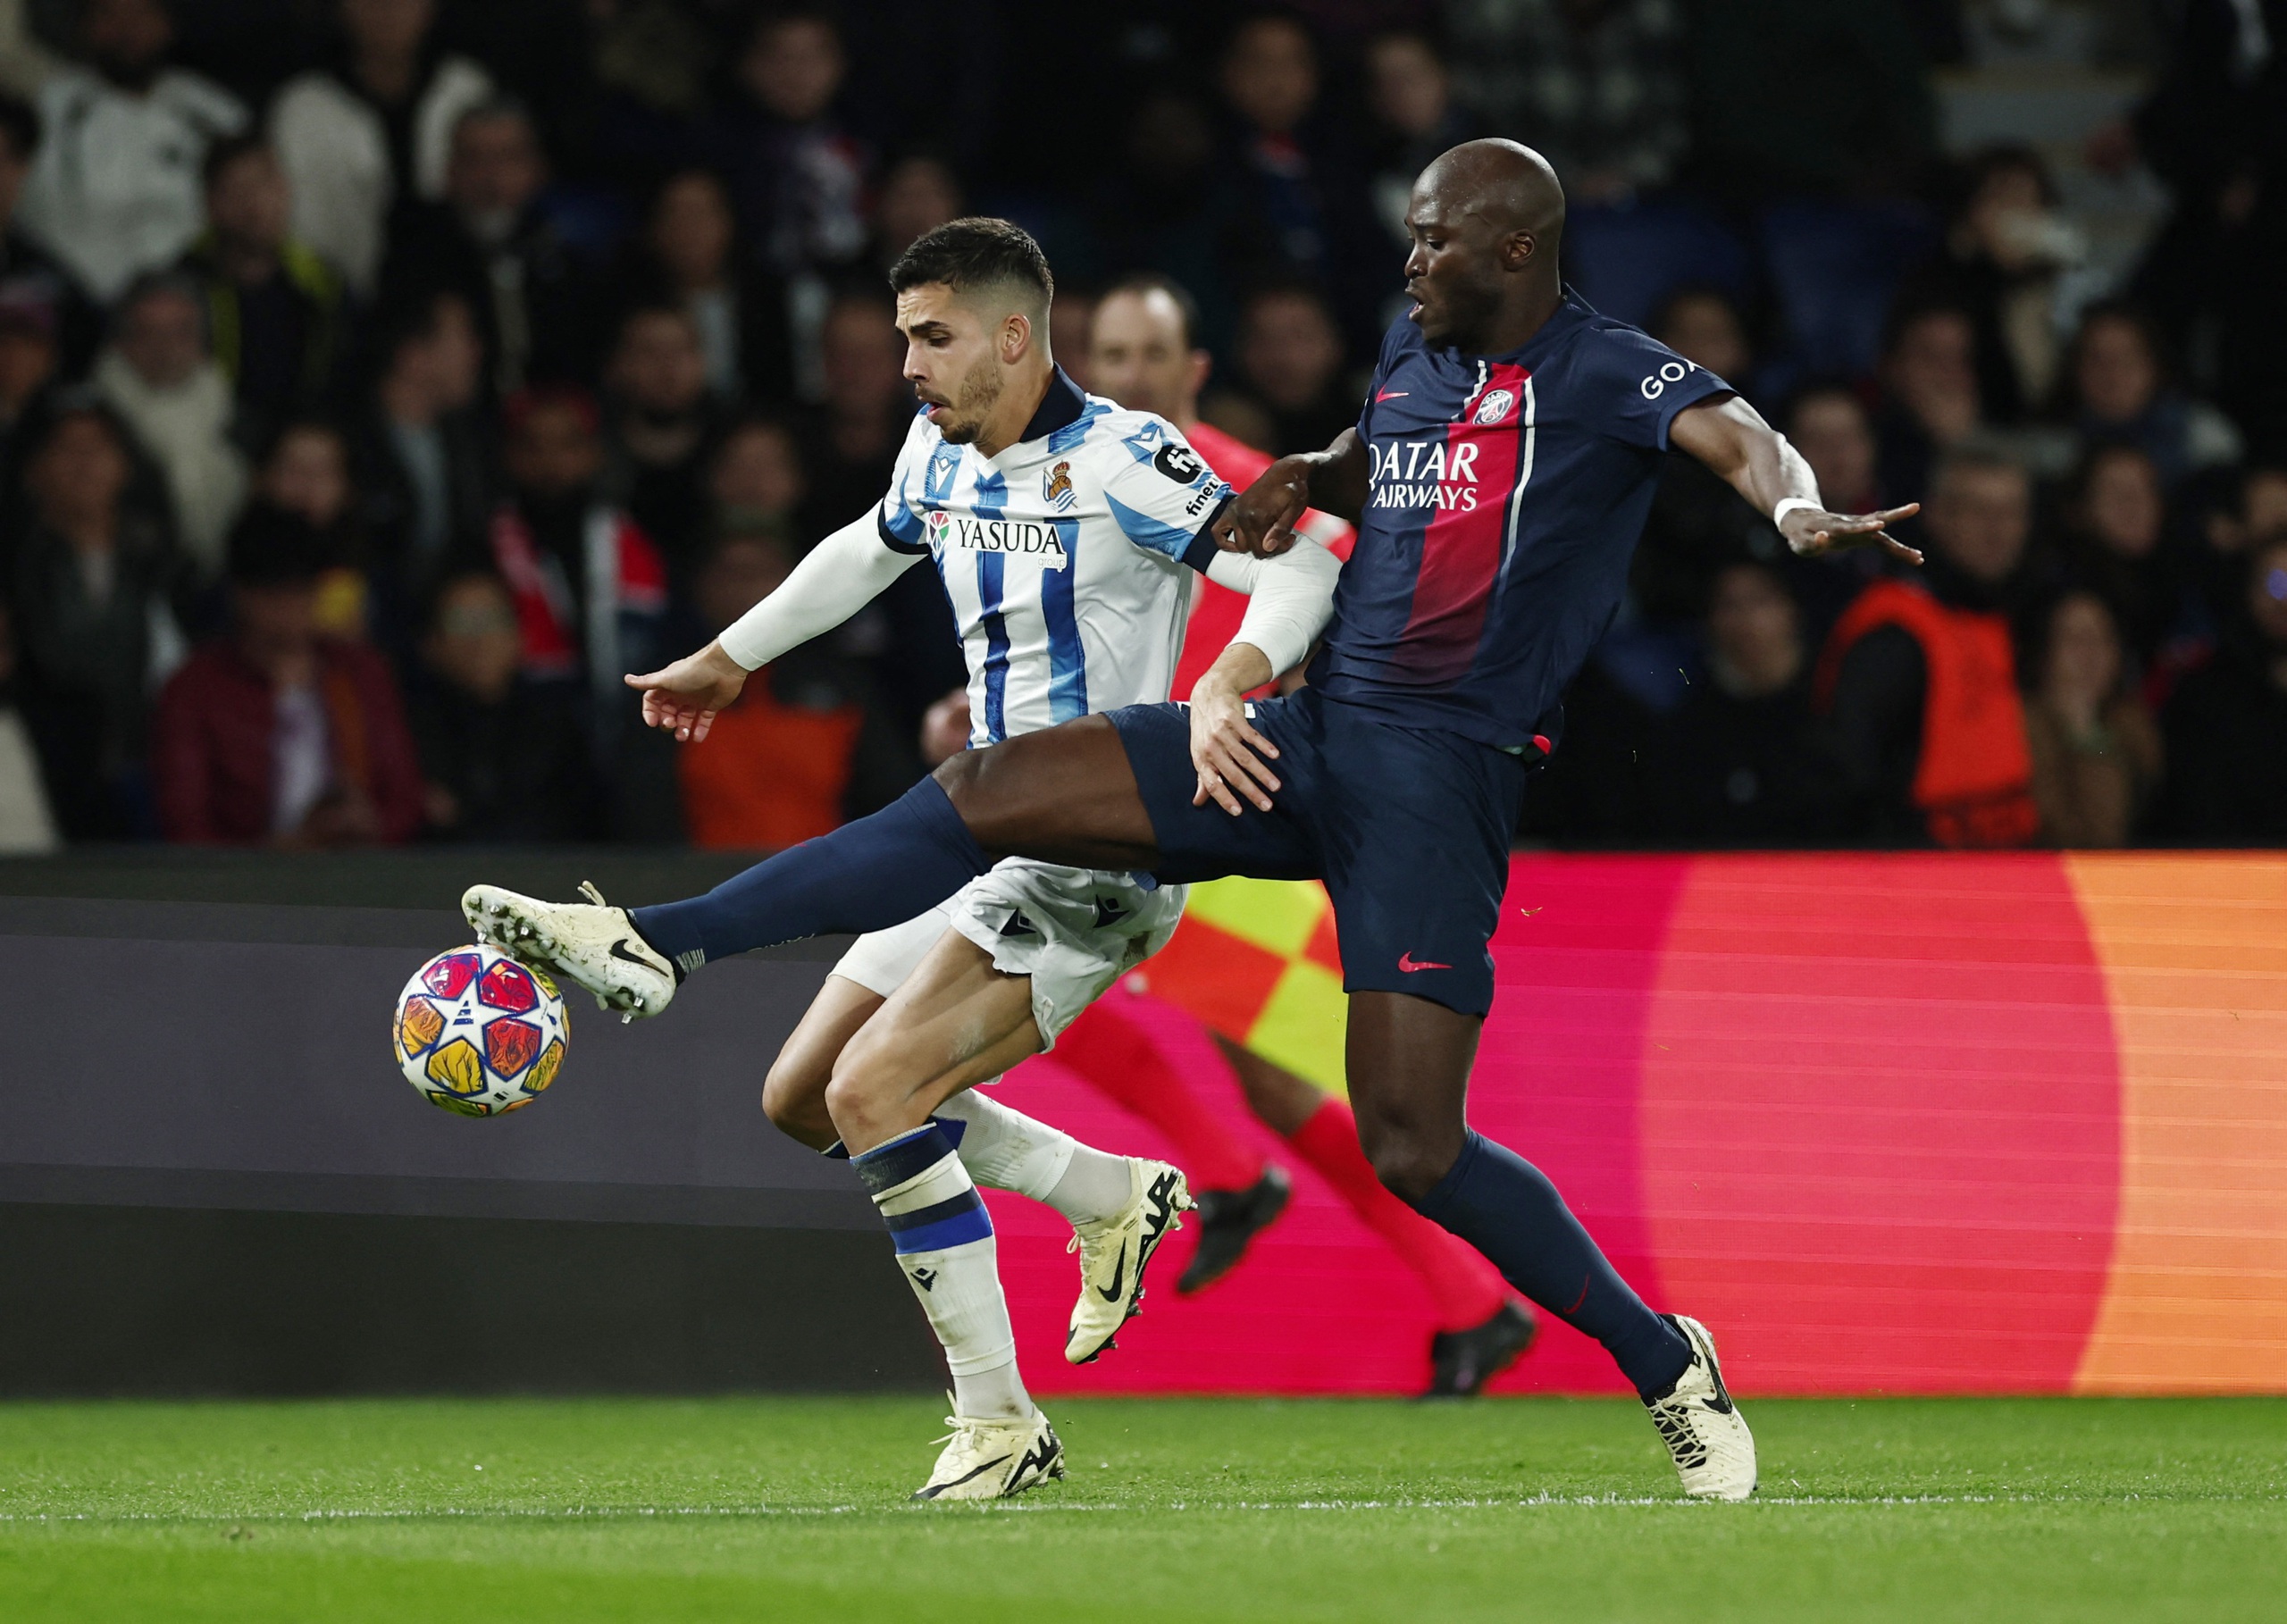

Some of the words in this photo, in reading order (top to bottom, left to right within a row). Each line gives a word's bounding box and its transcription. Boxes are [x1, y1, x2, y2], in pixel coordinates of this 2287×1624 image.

[1185, 477, 1219, 516] finet
[1372, 484, 1478, 512] AIRWAYS
[957, 519, 1065, 555] YASUDA
[1037, 557, 1066, 571] group
